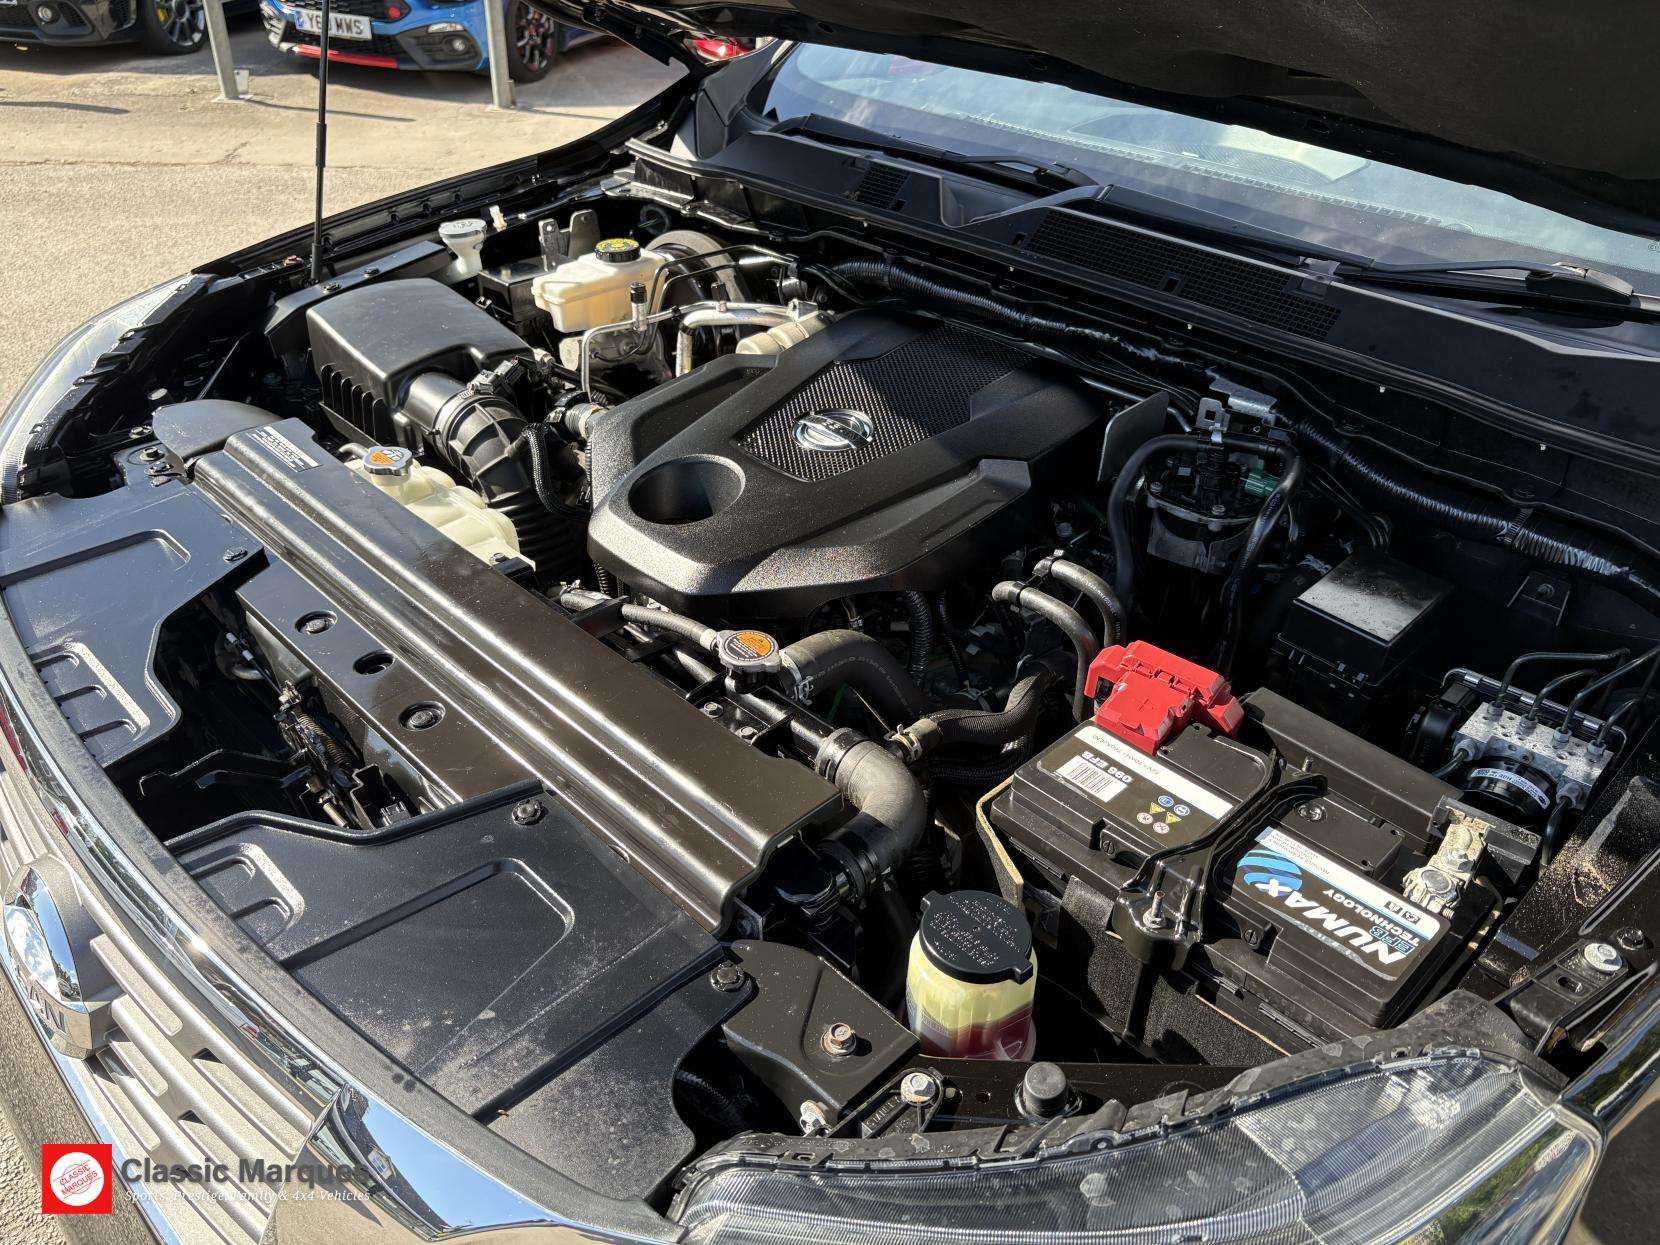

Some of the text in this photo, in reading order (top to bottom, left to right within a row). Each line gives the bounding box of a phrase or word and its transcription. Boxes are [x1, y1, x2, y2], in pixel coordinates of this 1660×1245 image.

[1081, 750, 1134, 784] 096 EFB
[1254, 878, 1407, 965] NUMAX
[1323, 888, 1420, 947] TECHNOLOGY
[1369, 925, 1415, 955] EFB
